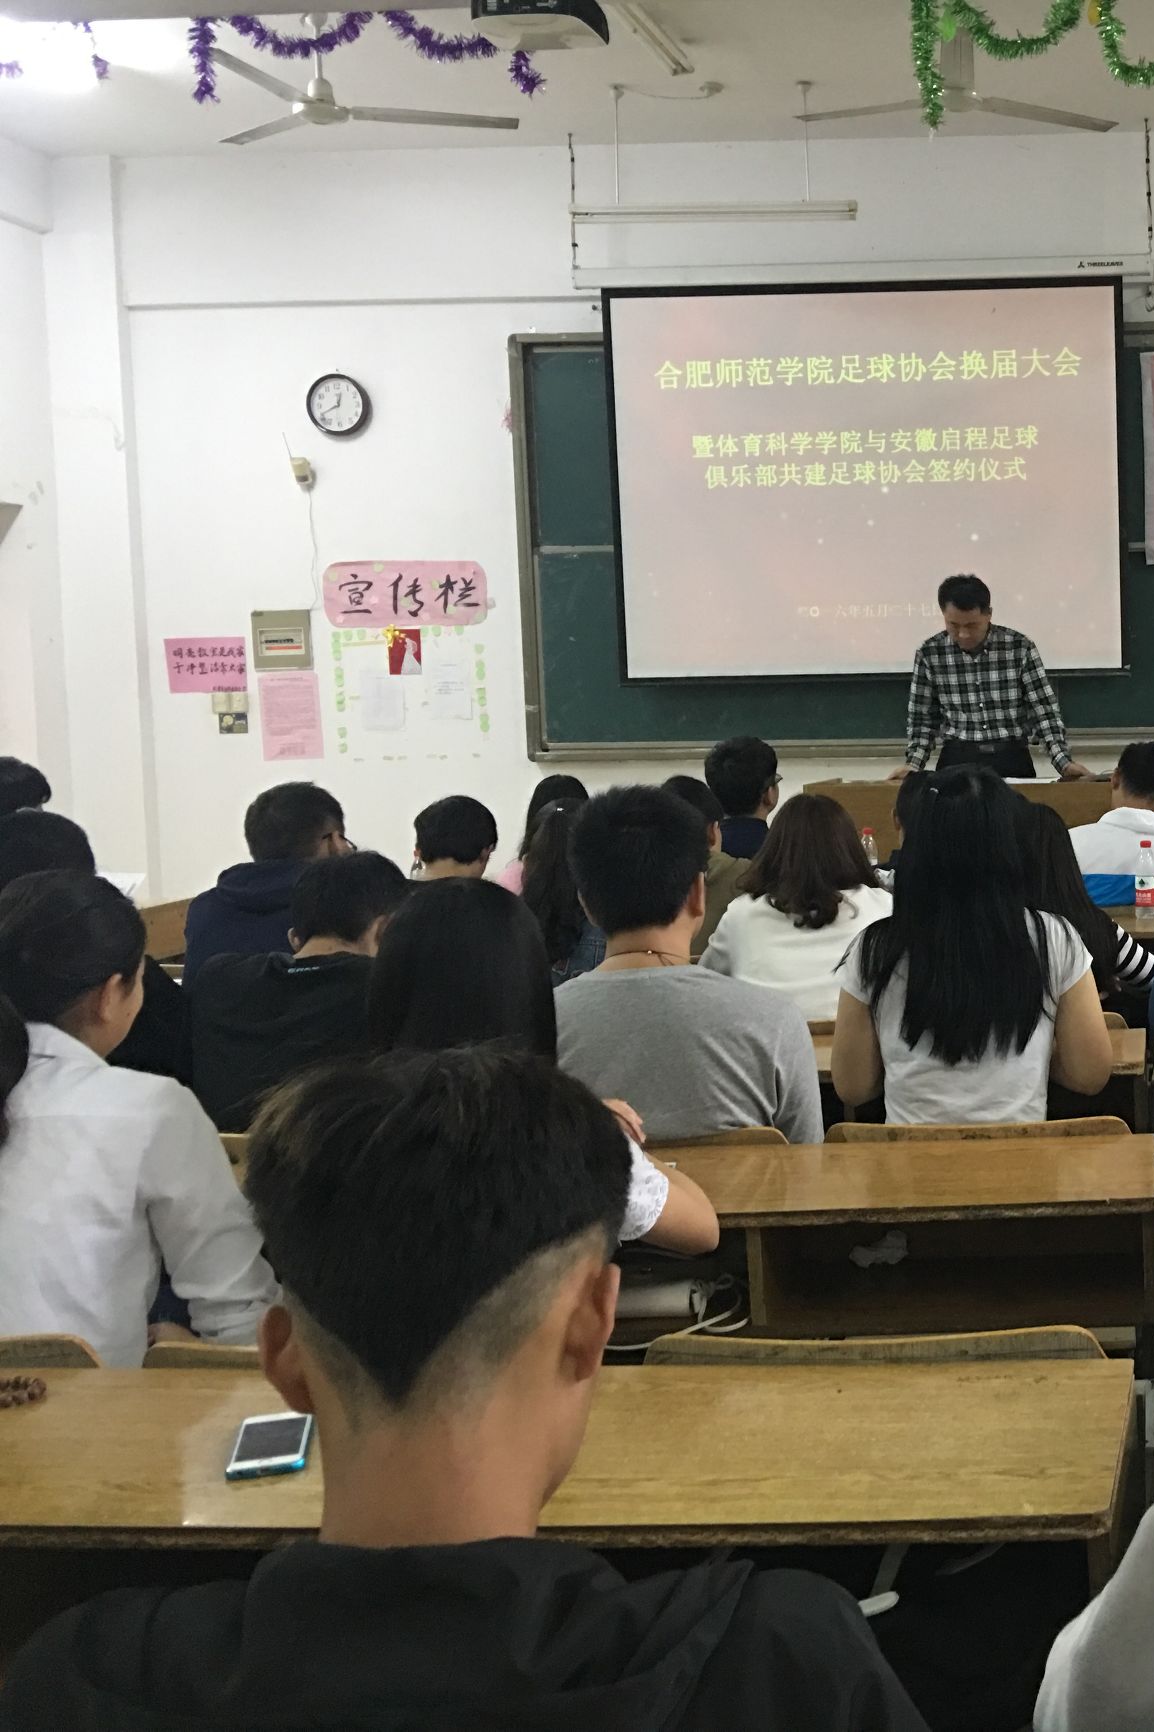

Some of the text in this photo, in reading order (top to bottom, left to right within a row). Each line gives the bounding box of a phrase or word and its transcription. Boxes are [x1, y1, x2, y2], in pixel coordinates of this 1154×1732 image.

[654, 346, 1083, 390] 合肥师范学院足球协会换届大会
[692, 424, 1039, 458] 暨体育科学学院与安徽启程足球
[704, 456, 1027, 489] 俱乐部共建足球协会签约仪式
[338, 573, 480, 617] 宣传栏
